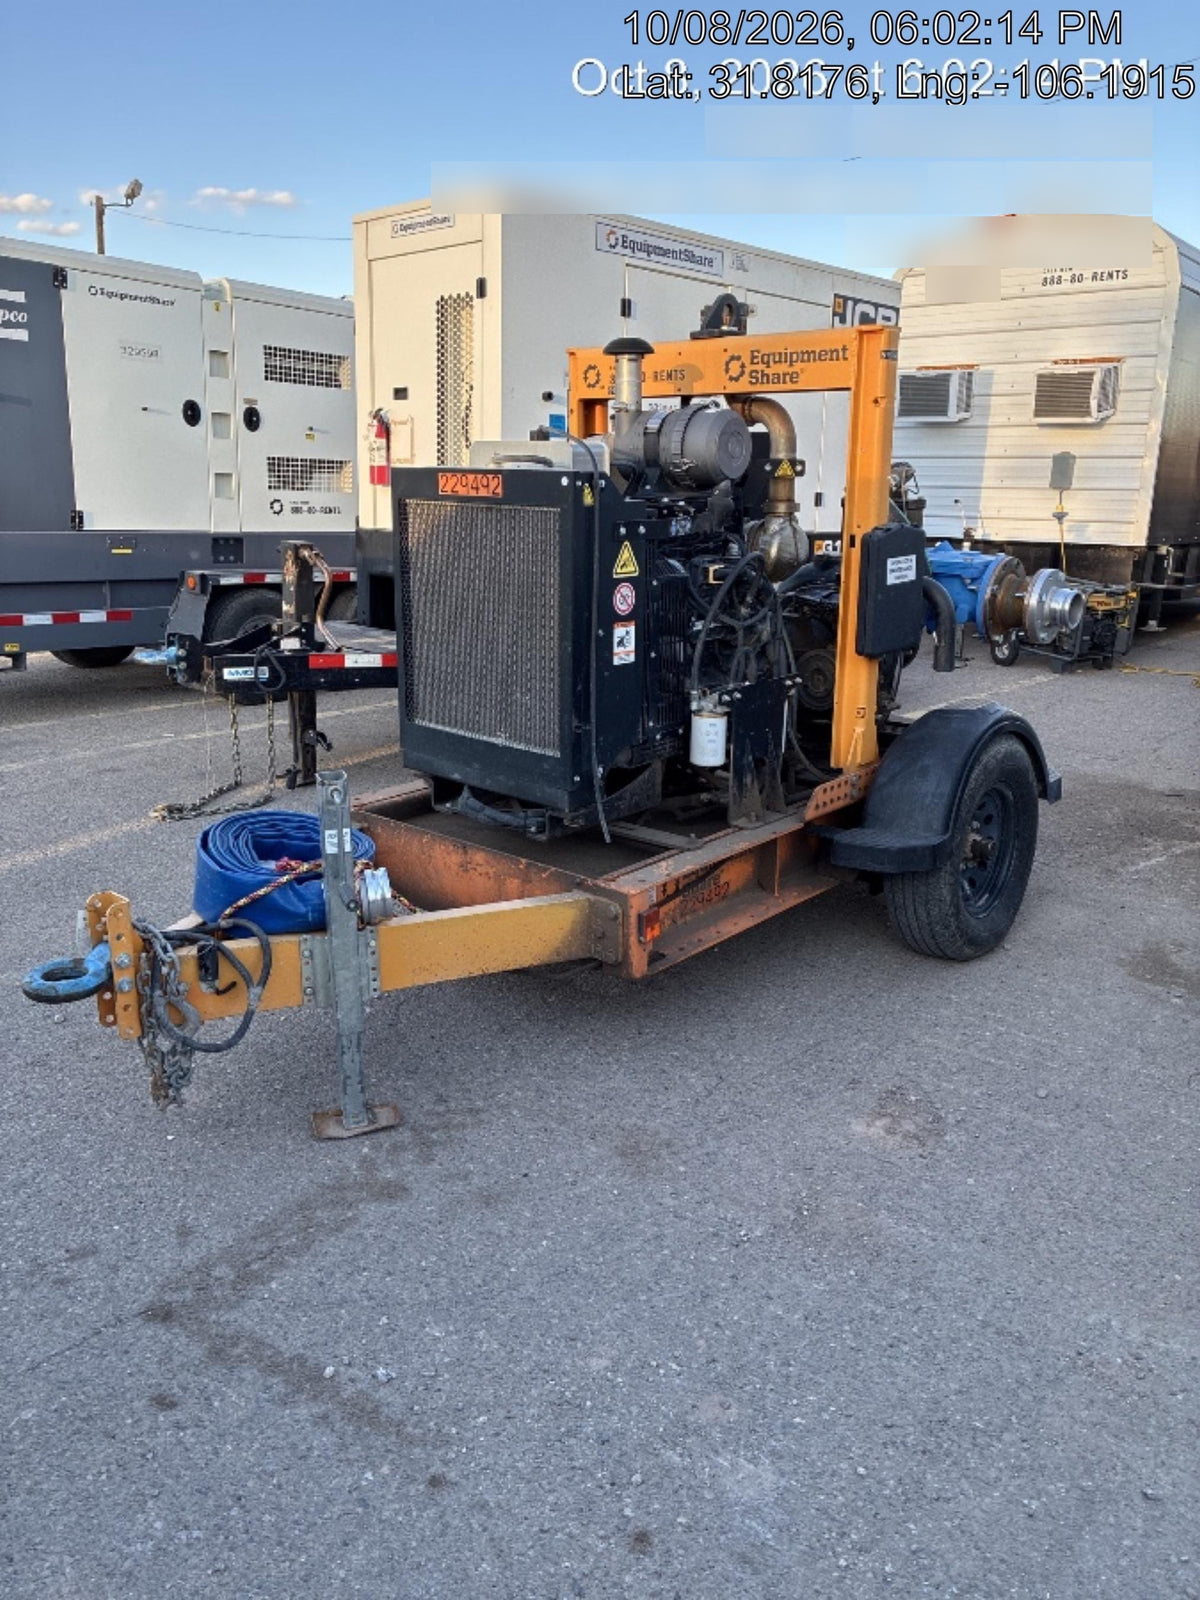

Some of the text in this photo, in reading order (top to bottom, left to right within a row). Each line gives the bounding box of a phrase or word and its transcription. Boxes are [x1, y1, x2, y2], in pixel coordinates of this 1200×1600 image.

[620, 234, 716, 268] EquipmentShare
[1041, 269, 1129, 287] 888-80-RENTS
[749, 344, 849, 369] Equipment
[748, 369, 800, 386] Share
[440, 473, 500, 496] 229492
